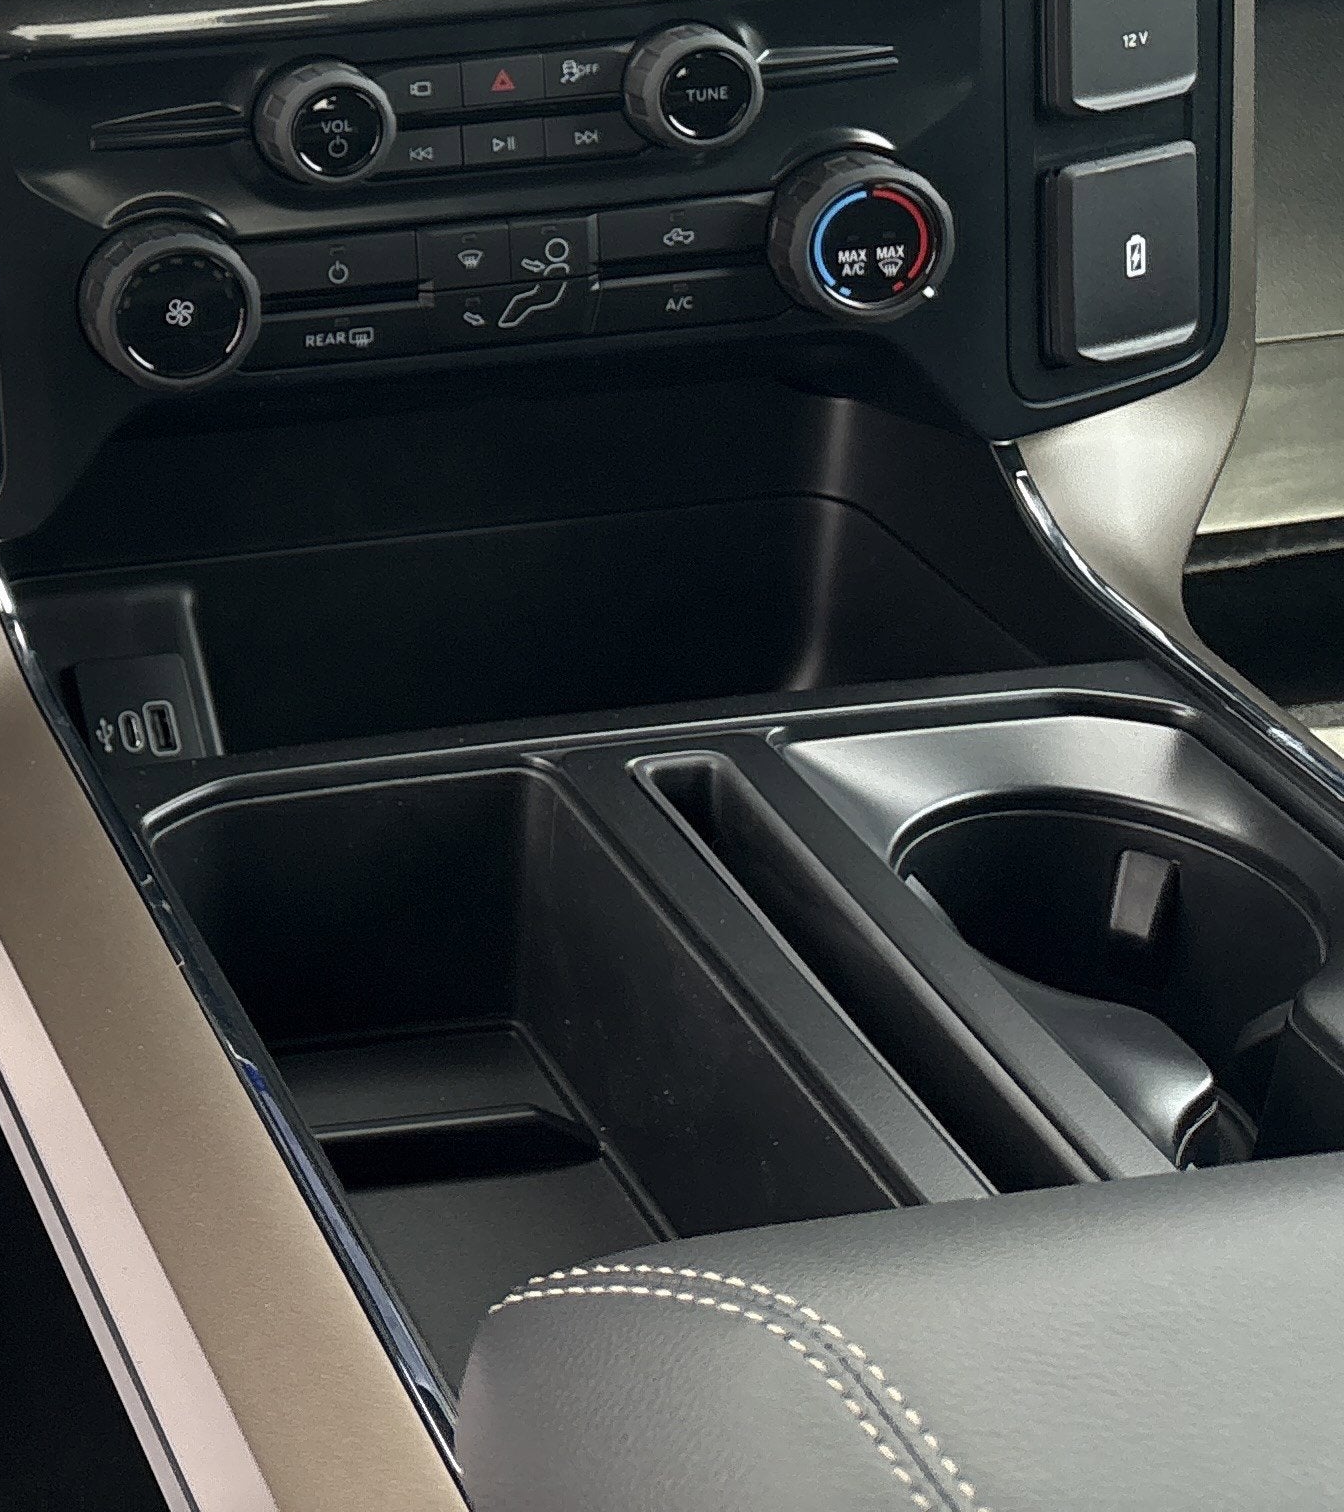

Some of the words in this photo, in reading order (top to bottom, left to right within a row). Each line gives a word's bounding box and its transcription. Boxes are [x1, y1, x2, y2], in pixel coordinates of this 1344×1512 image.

[579, 61, 600, 76] OFF
[685, 87, 728, 102] TUNE
[321, 120, 353, 133] VOL
[838, 249, 867, 264] MAX
[876, 244, 905, 260] MAX
[842, 262, 865, 277] A/C
[666, 296, 694, 312] A/C
[305, 330, 346, 347] REAR
